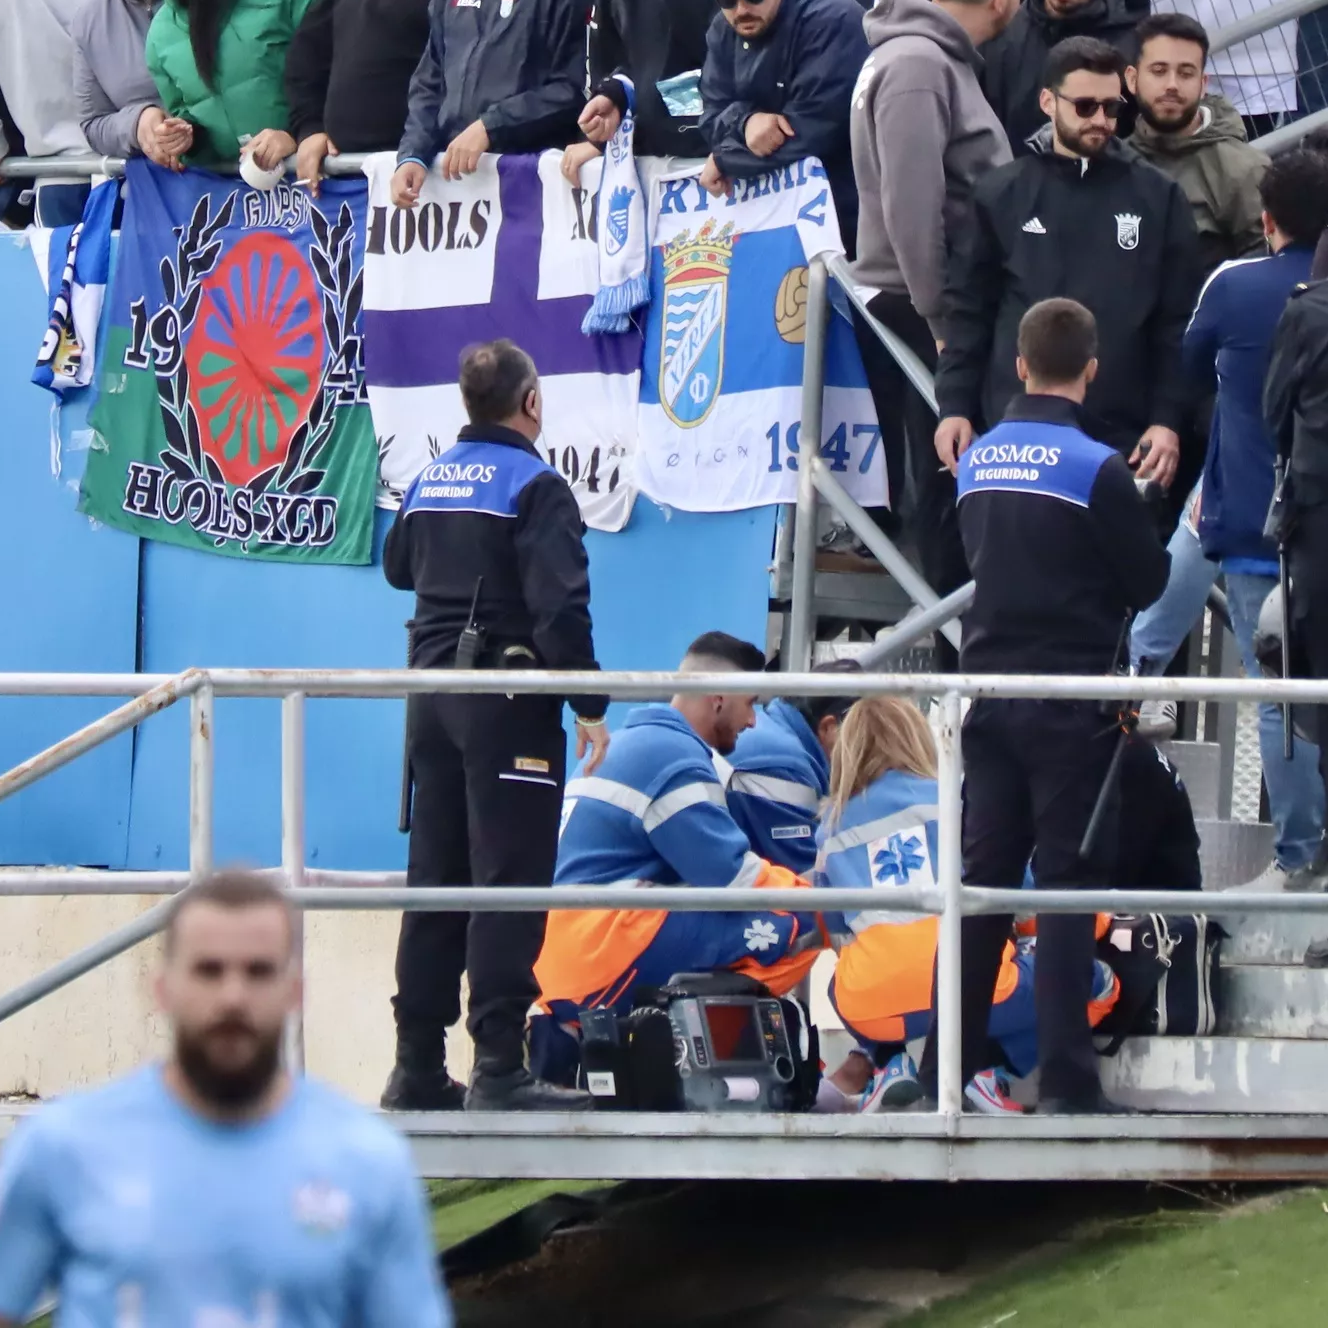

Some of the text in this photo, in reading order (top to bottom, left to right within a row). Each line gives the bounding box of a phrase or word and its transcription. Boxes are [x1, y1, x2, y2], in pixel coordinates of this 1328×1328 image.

[123, 295, 184, 378] 19
[323, 333, 369, 407] 4
[766, 422, 881, 475] 1947
[969, 445, 1061, 467] KOSMOS
[420, 464, 497, 483] KOSMOS
[974, 468, 1039, 481] SEGURIDAD
[419, 486, 474, 498] SEGURIDAD
[123, 462, 339, 548] HOOLS XCD
